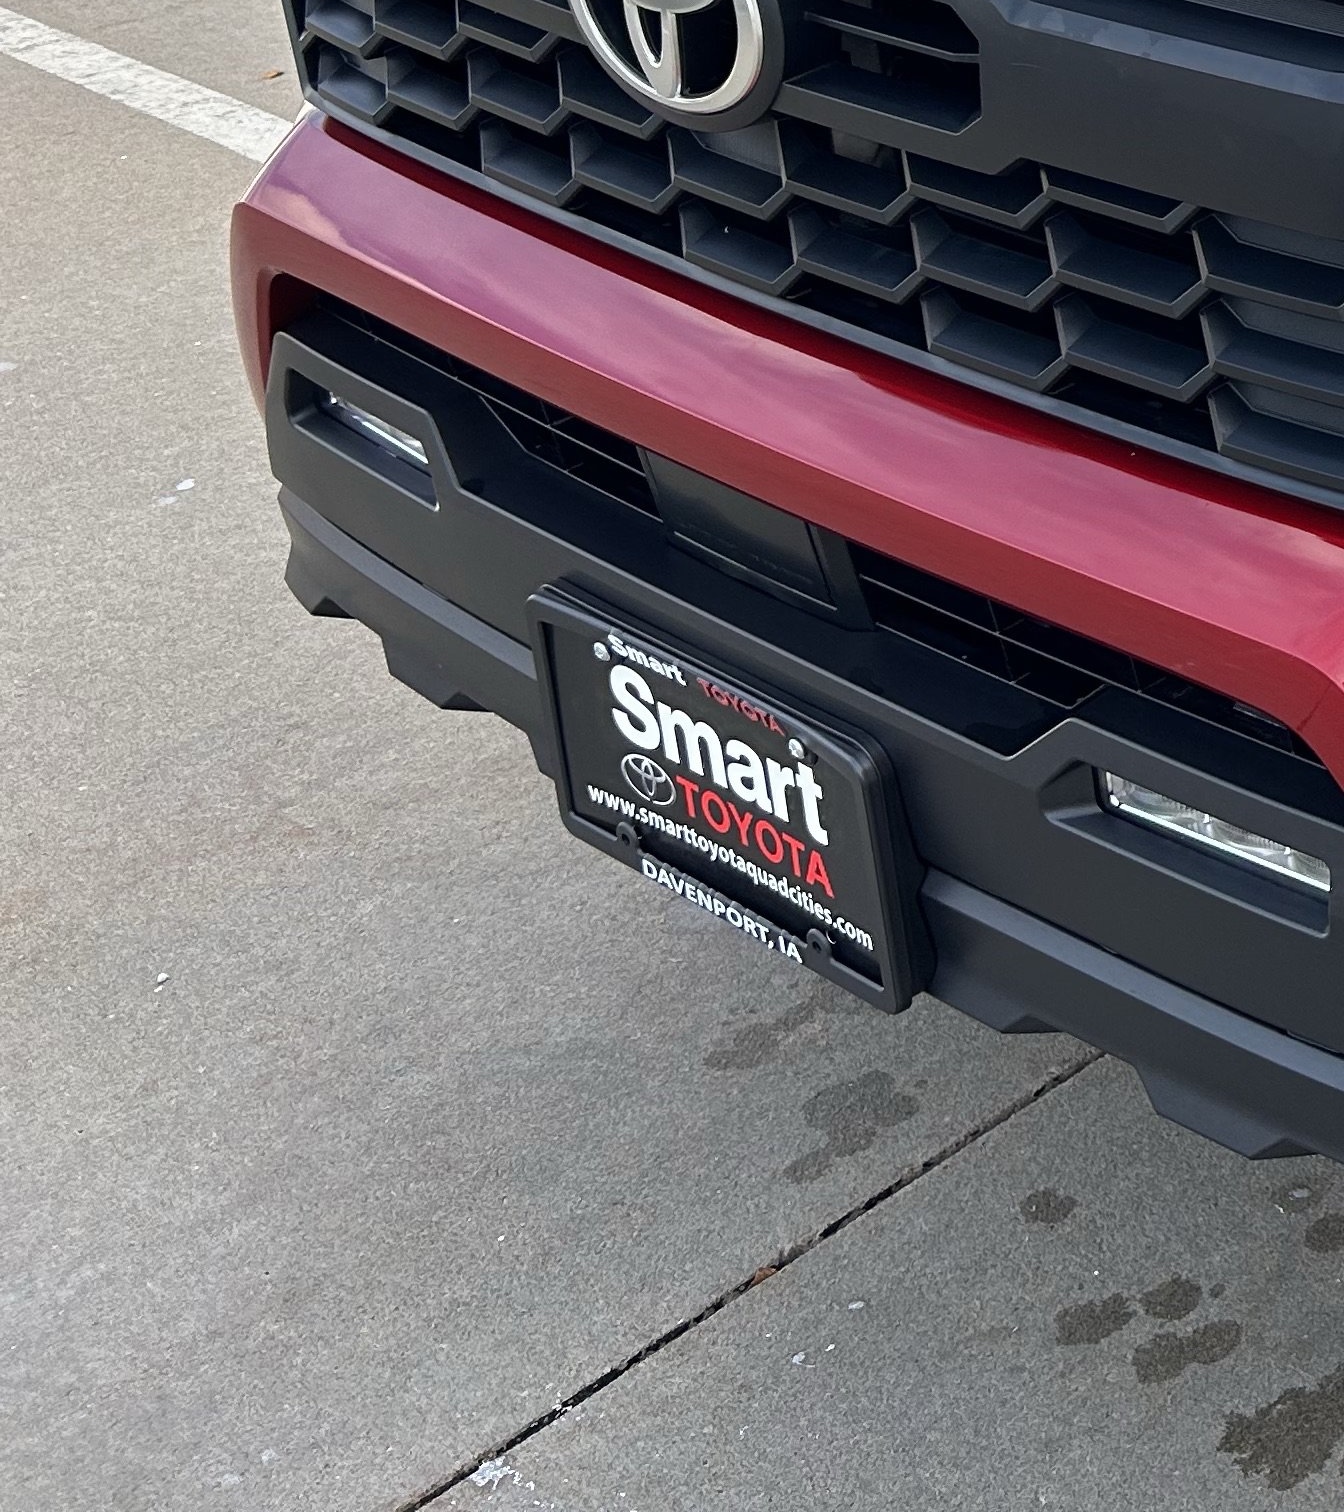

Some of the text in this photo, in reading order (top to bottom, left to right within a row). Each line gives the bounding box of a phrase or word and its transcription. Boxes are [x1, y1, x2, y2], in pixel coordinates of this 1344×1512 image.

[607, 633, 785, 736] Smart TOYOTA
[609, 664, 829, 846] Smart
[587, 785, 874, 951] www.smarttoyotaquadcities.com
[675, 775, 835, 898] TOYOTA
[641, 858, 803, 964] DAVENPORT, IA
